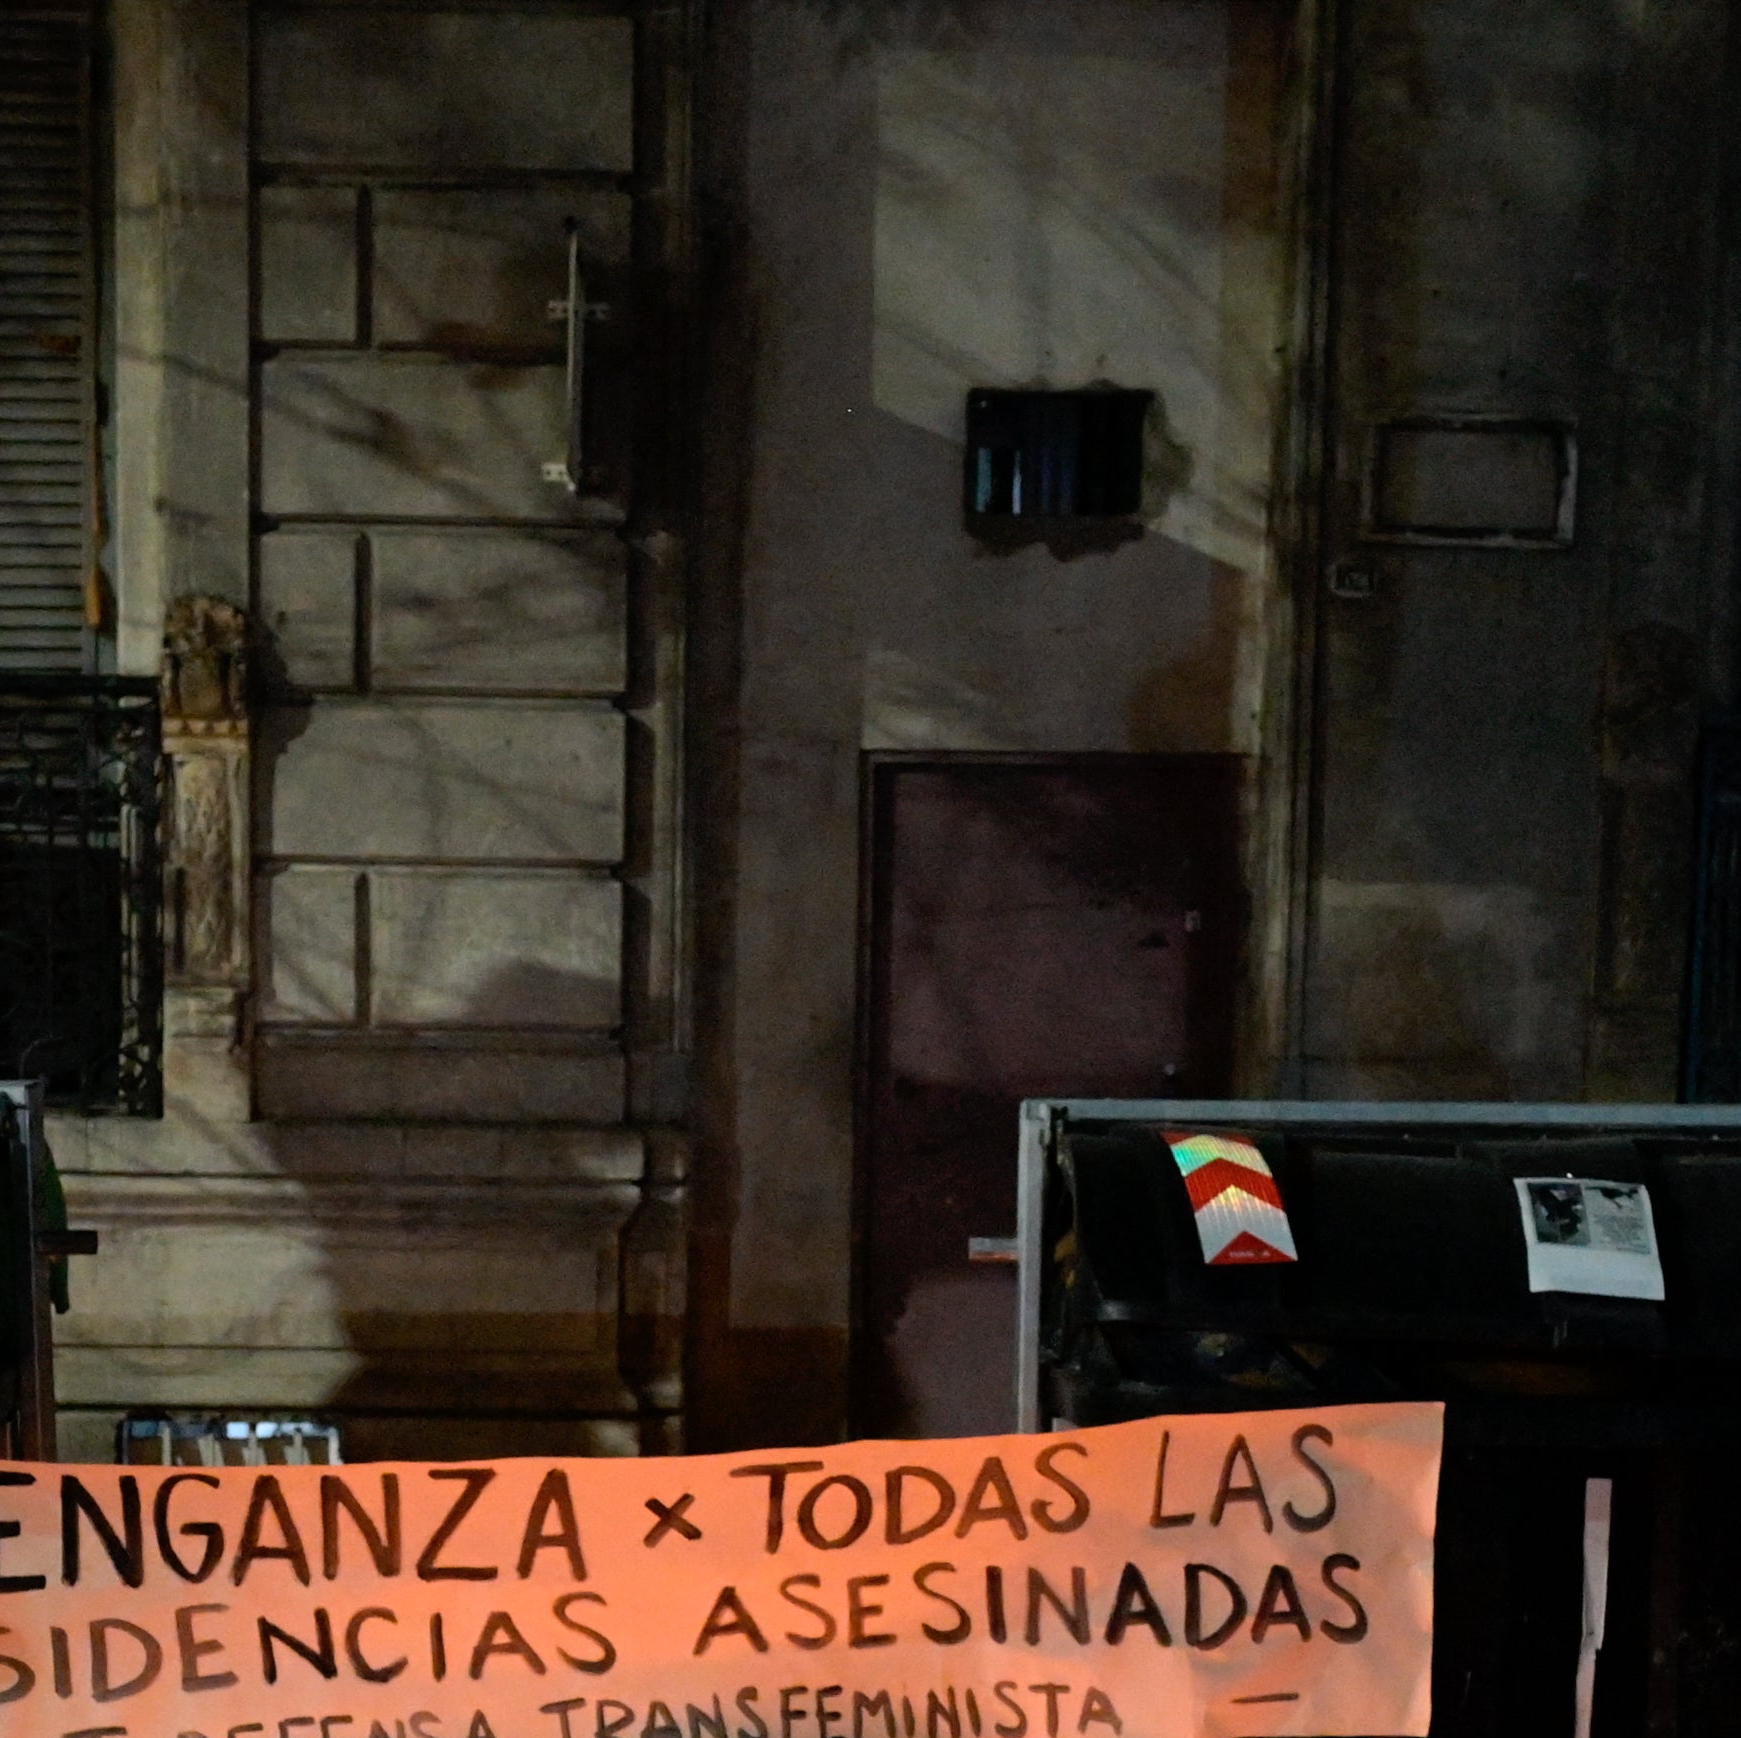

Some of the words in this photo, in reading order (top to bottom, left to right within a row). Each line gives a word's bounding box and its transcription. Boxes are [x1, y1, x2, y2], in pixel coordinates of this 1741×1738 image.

[730, 1442, 1093, 1555] TODAS
[1149, 1424, 1338, 1533] LAS
[693, 1553, 1370, 1656] ASESINADAS
